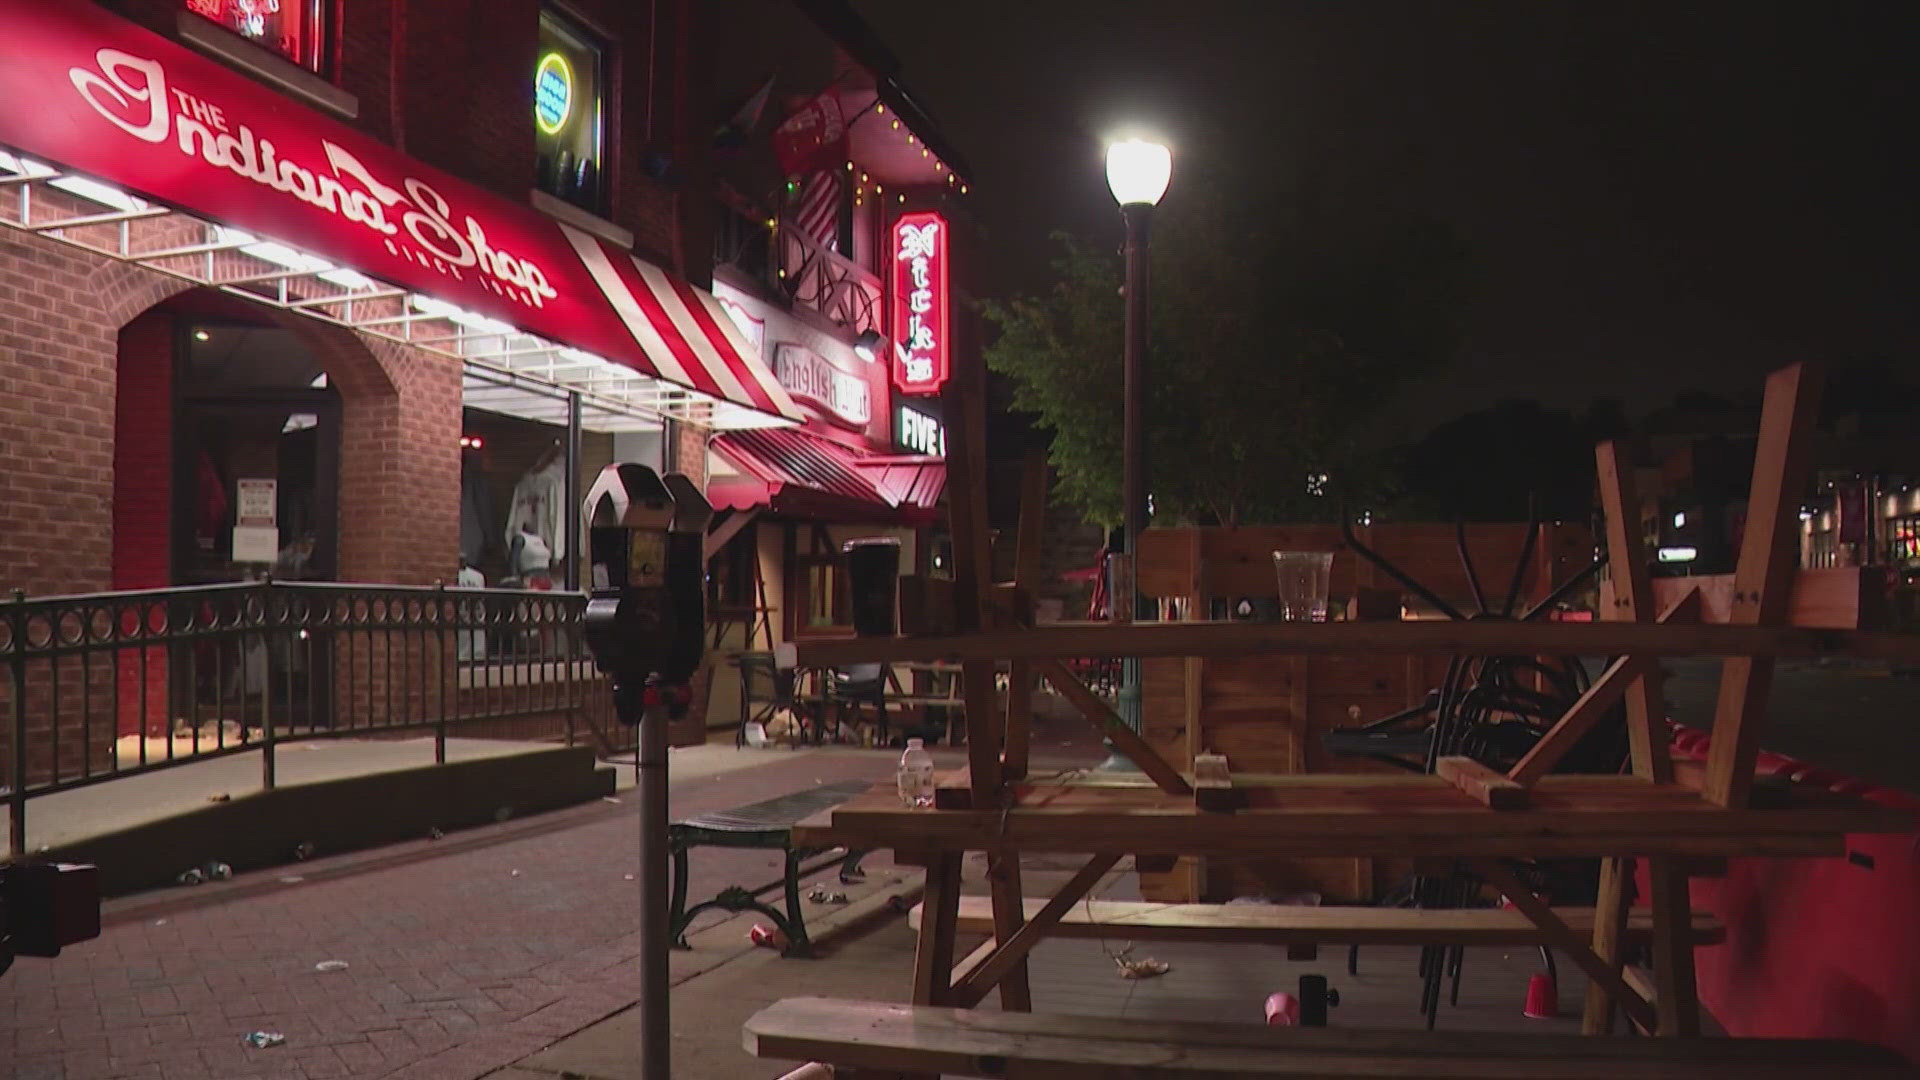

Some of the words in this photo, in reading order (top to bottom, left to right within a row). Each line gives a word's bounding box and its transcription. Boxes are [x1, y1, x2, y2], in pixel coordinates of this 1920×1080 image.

[171, 87, 229, 133] THE
[68, 48, 398, 235] Indiana
[402, 177, 558, 308] Shop
[384, 238, 464, 281] SINCE
[782, 349, 838, 410] English
[901, 405, 938, 456] FIVE
